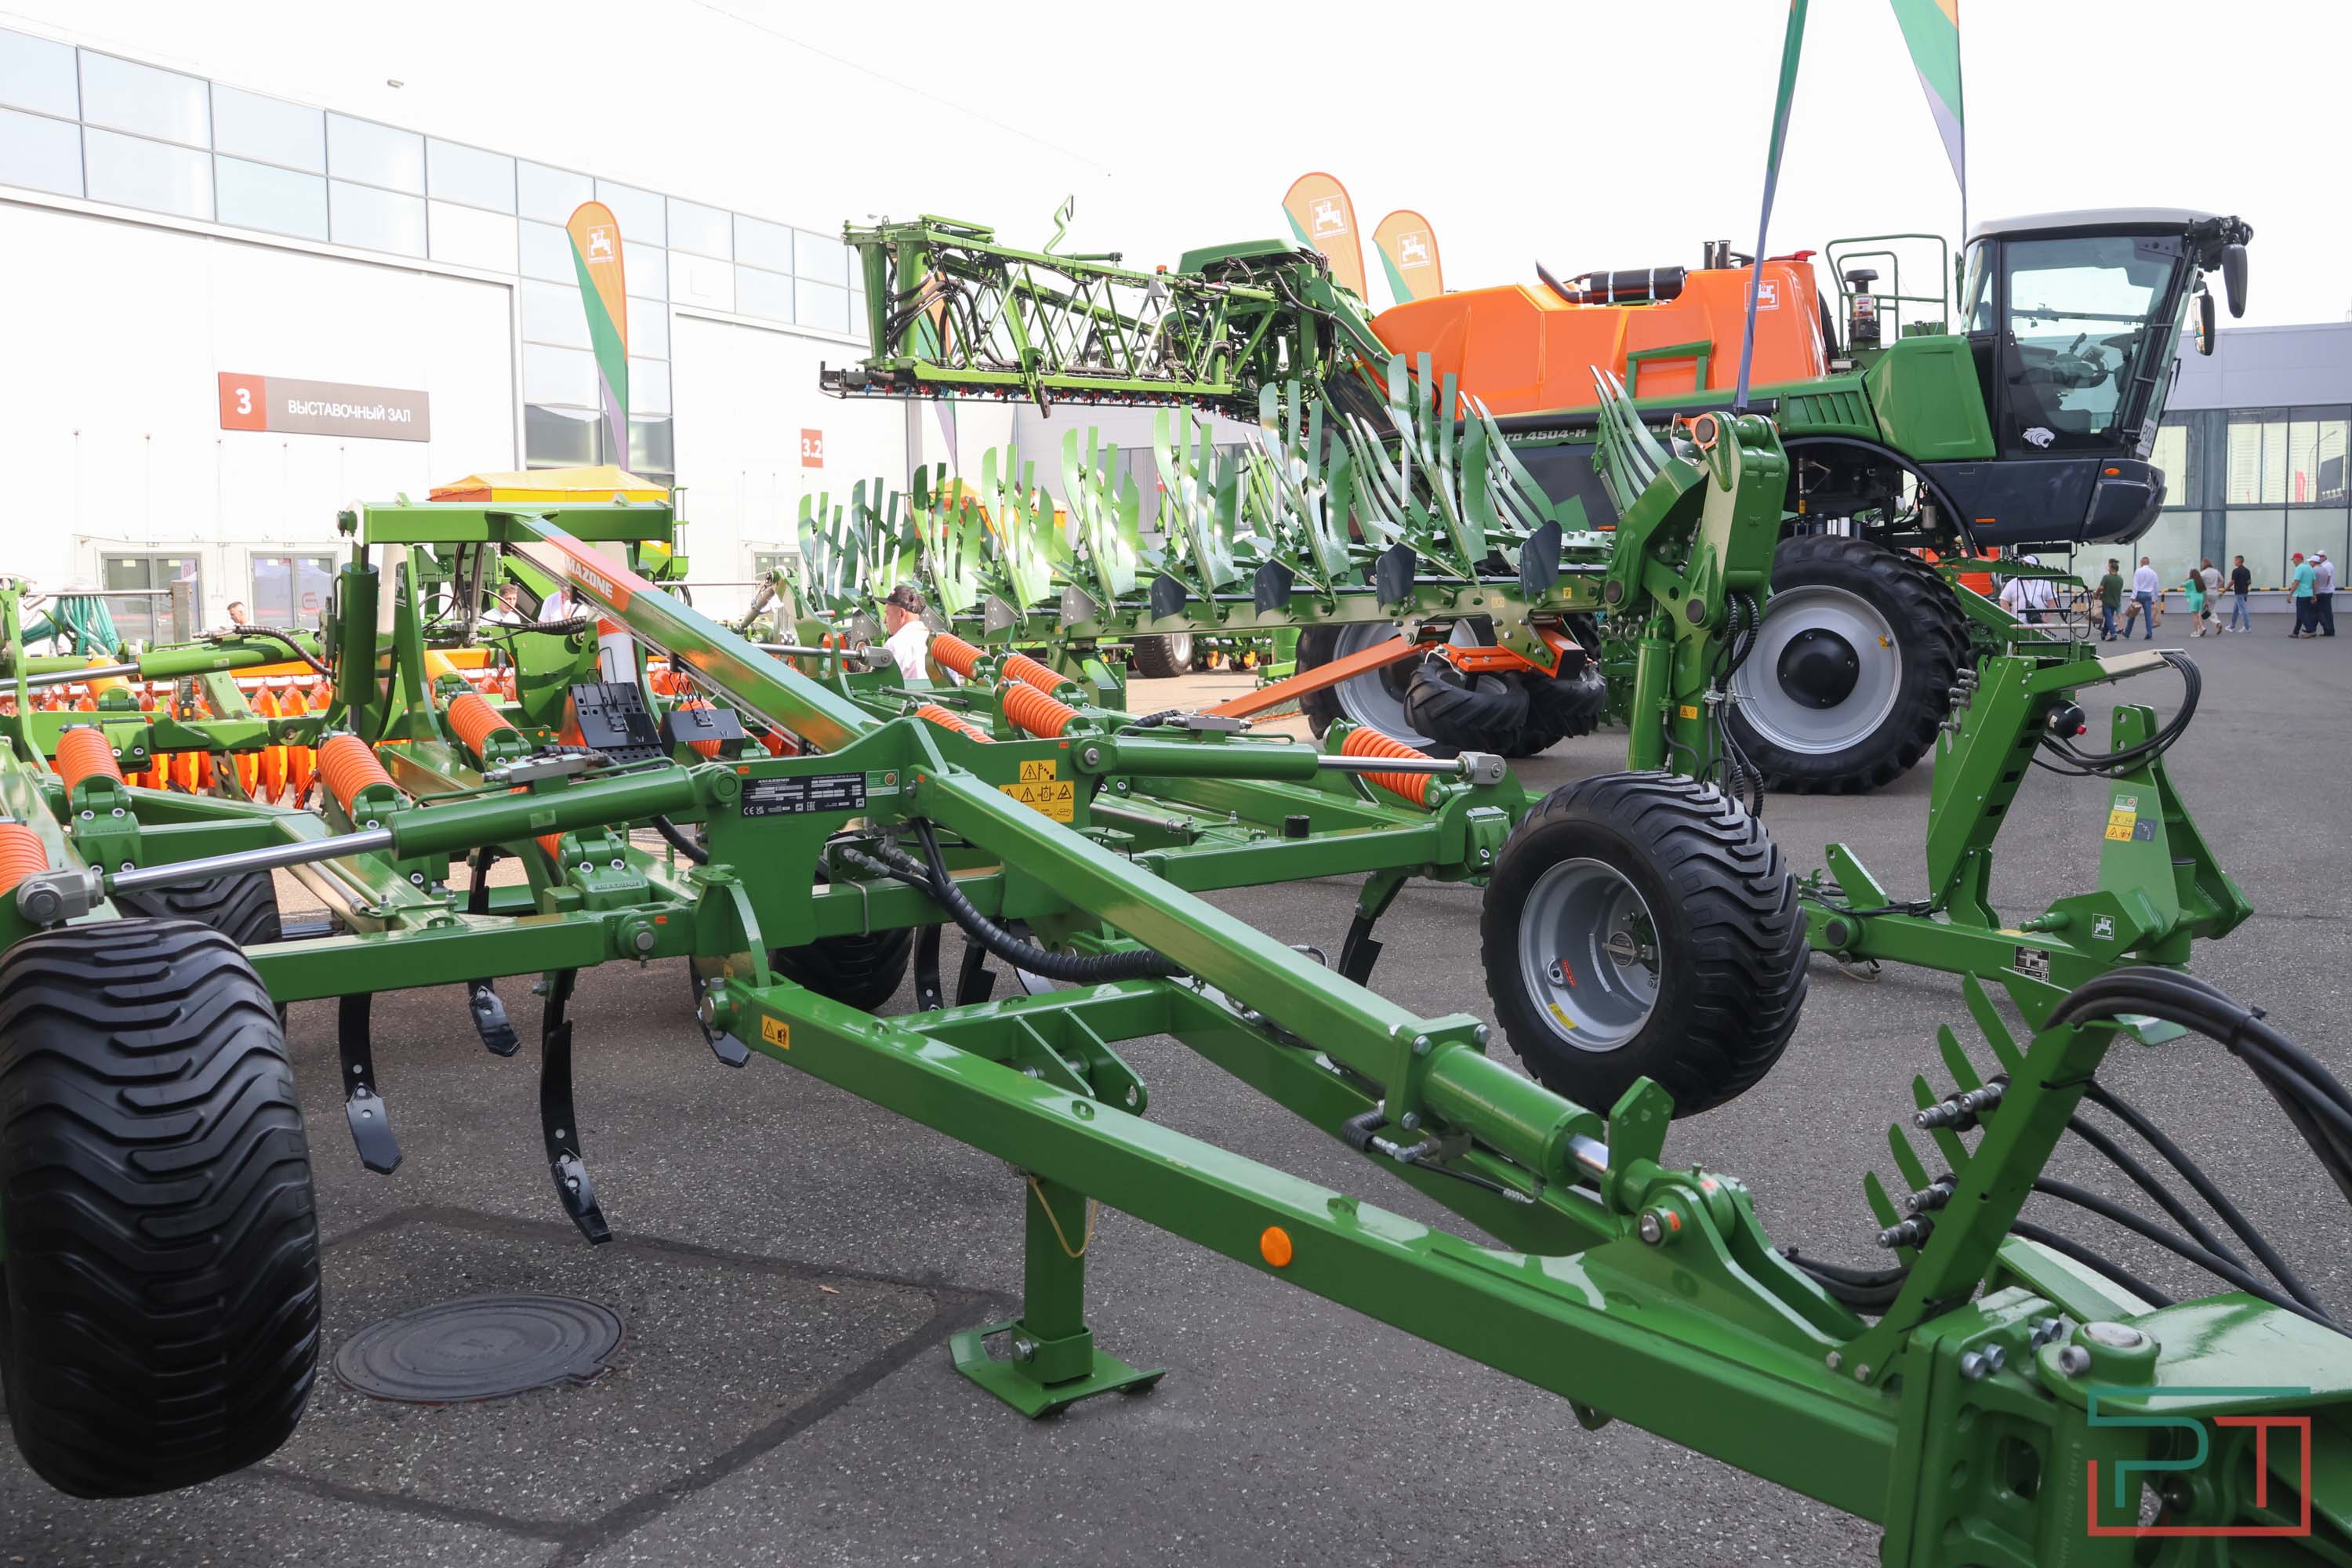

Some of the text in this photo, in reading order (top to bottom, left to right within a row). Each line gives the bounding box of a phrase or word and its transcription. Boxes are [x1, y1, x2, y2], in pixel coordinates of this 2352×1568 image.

[235, 388, 411, 423] 3 ВЫСТАВОЧНЫЙ ЗАЛ
[1526, 429, 1587, 441] 4504-H
[802, 438, 822, 458] 3.2
